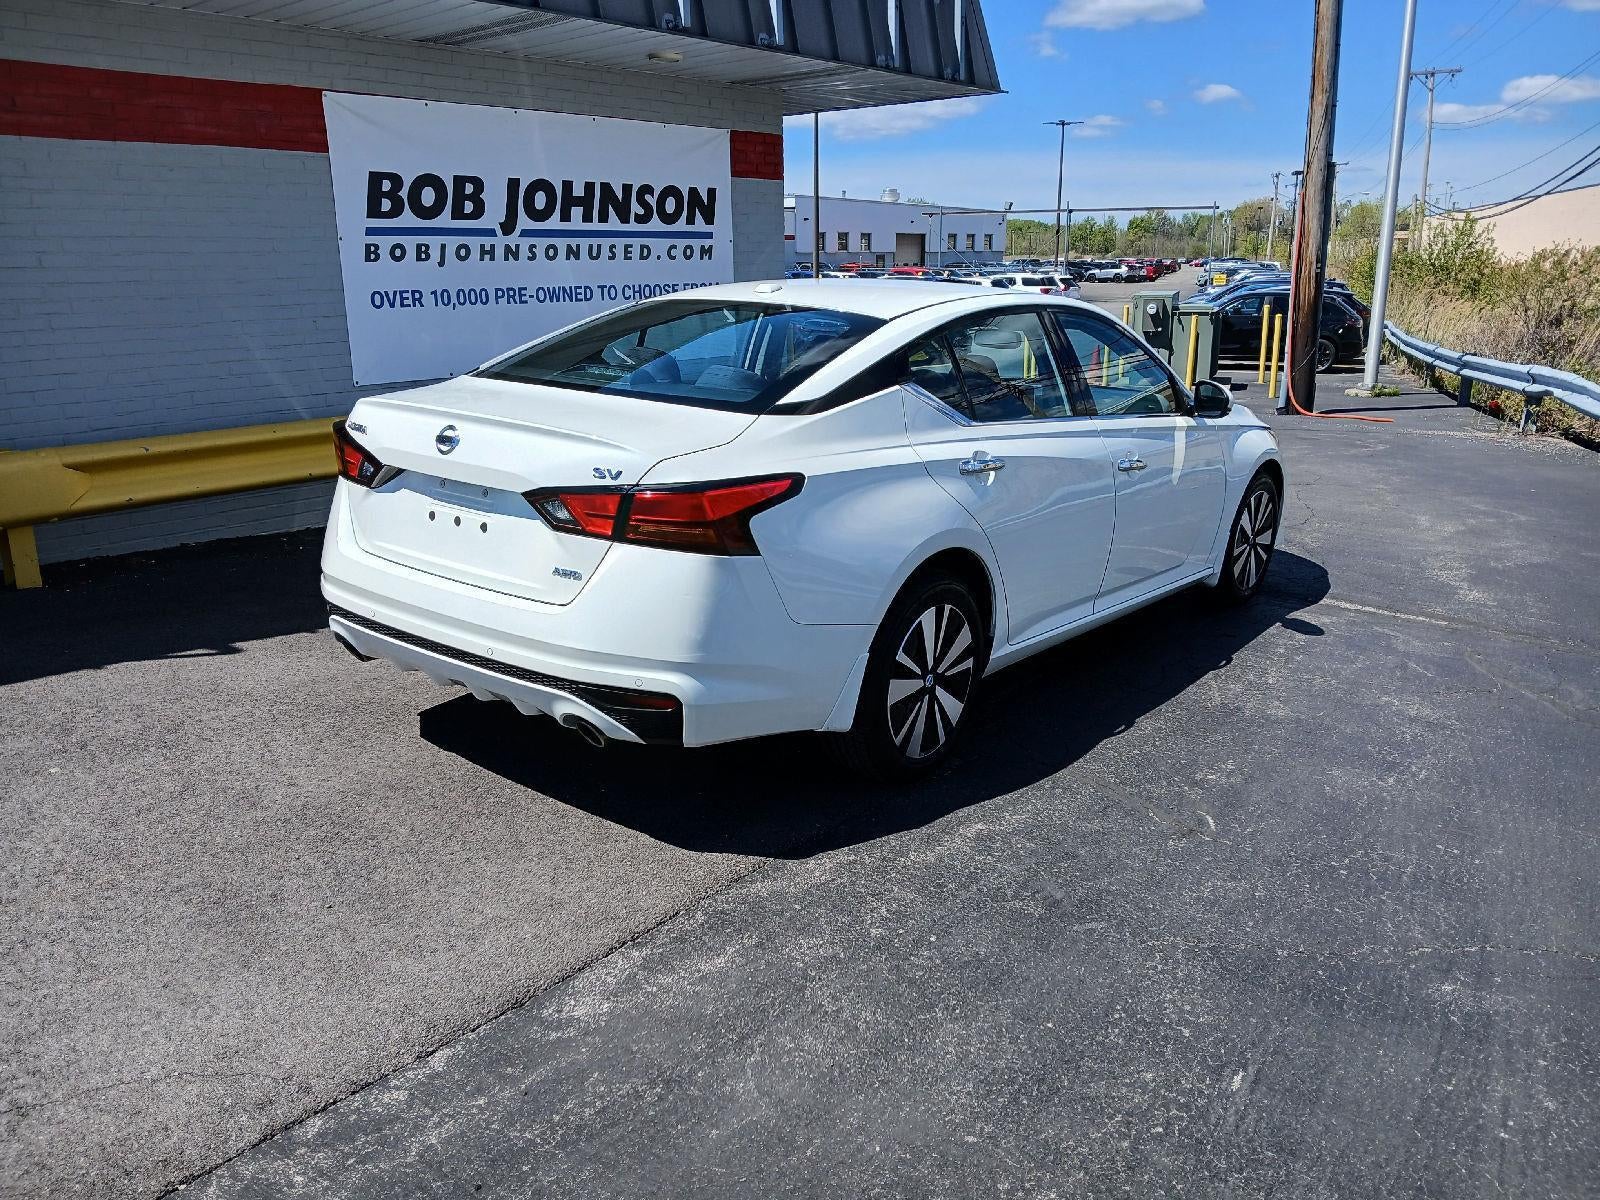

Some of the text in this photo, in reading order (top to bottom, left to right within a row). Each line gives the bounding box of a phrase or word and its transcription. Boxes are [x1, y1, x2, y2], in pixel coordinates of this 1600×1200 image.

[366, 171, 717, 237] BOB JOHNSON
[364, 243, 714, 268] BOBJOHNSONUSED.COM
[370, 290, 425, 310] OVER
[430, 288, 490, 310] 10,000
[495, 285, 594, 305] PRE-OWNED
[597, 284, 618, 302] TO
[592, 467, 623, 481] SV
